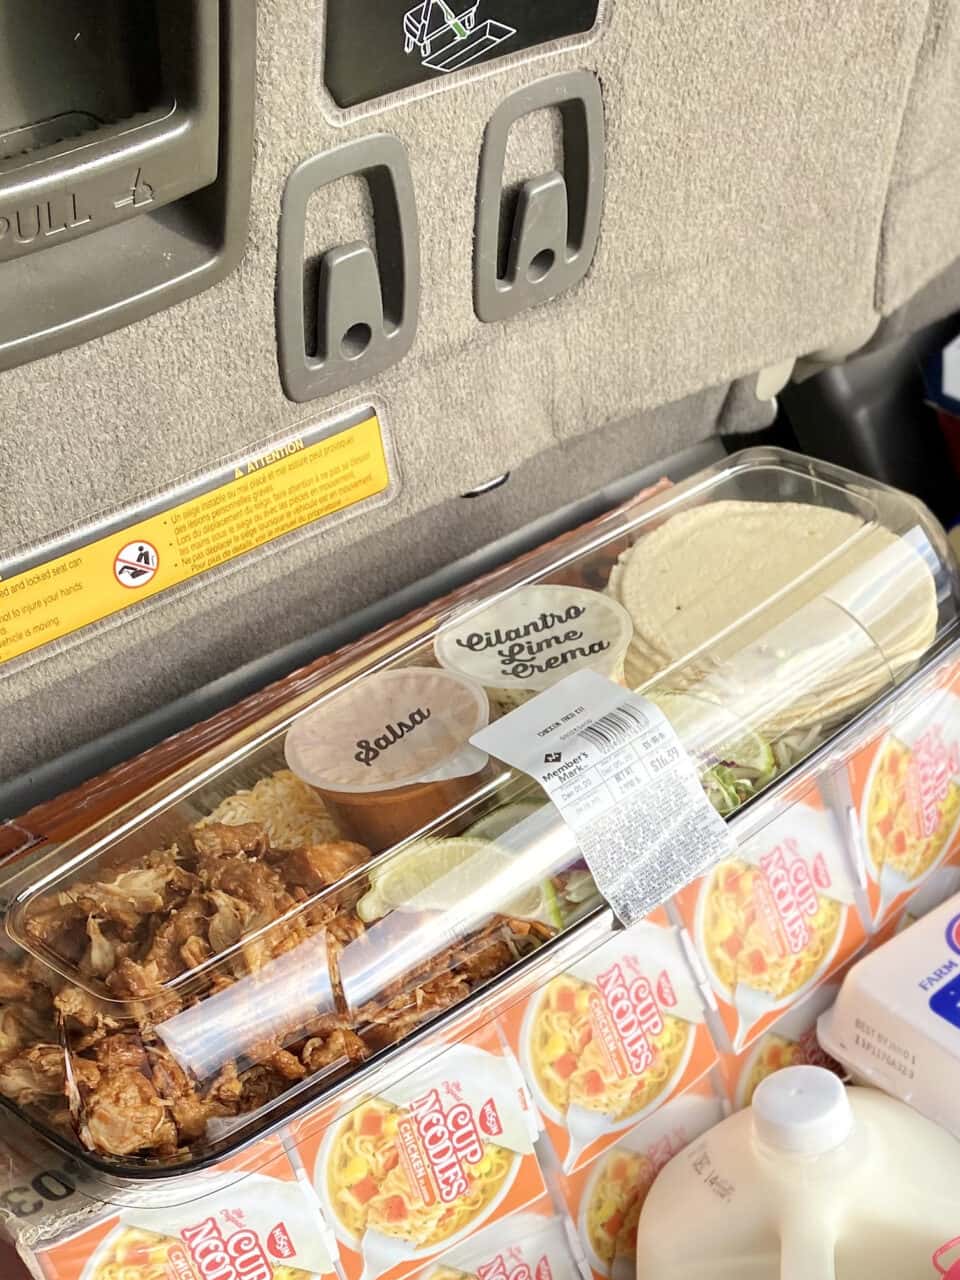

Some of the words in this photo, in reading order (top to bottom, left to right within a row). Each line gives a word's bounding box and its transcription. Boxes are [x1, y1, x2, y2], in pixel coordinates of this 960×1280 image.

[247, 439, 305, 474] ATTENTION
[456, 604, 587, 652] Cilantro
[497, 629, 584, 665] Lime
[502, 638, 611, 679] Crema
[354, 707, 431, 767] Salsa
[542, 751, 589, 782] Member's
[558, 765, 584, 783] Mark
[760, 846, 809, 954] NOODLES
[790, 857, 819, 916] CUP
[918, 960, 959, 992] FARM
[596, 963, 656, 1075] NOODLES
[629, 975, 664, 1036] CUP
[399, 1122, 426, 1177] CHICKEN
[410, 1088, 468, 1204] NOODLES
[447, 1103, 484, 1165] CUP
